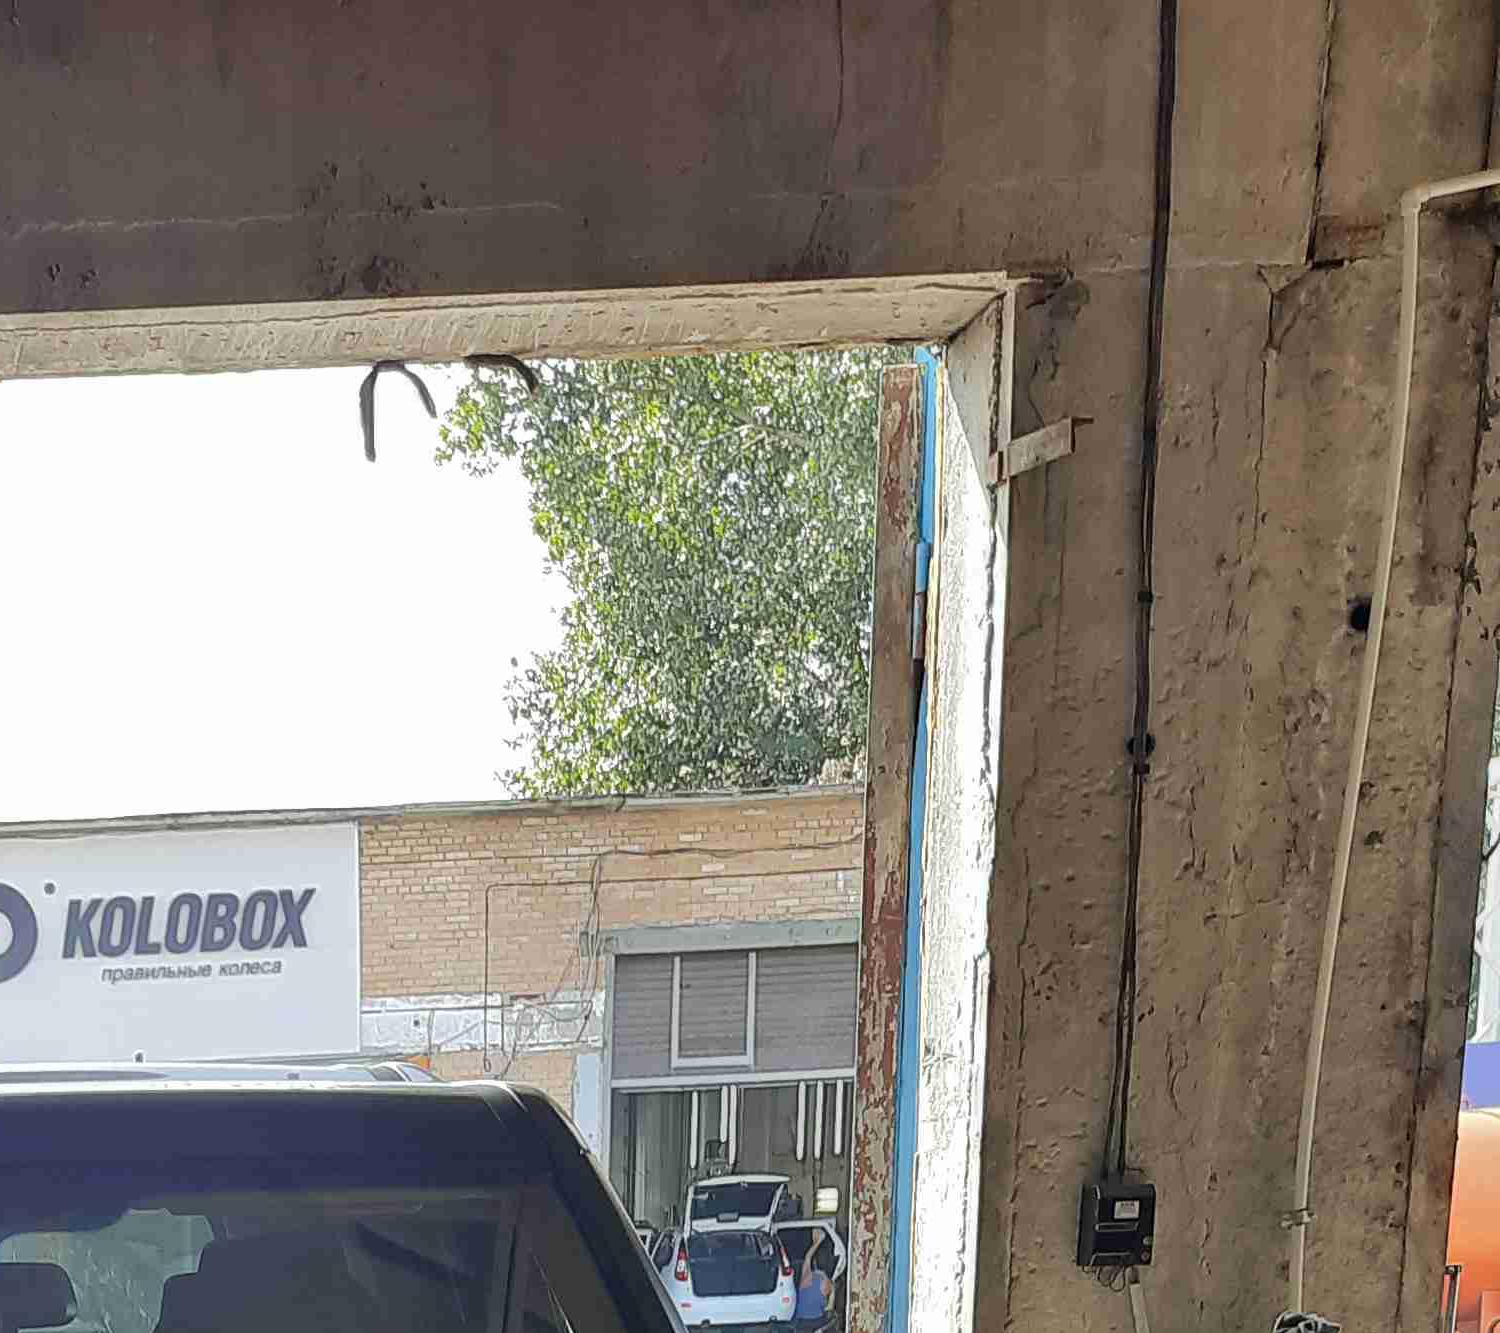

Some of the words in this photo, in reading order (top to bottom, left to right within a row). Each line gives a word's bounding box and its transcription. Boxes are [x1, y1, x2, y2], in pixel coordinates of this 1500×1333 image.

[62, 889, 316, 959] KOLOBOX
[101, 962, 213, 985] правильные
[219, 960, 283, 978] колеса
